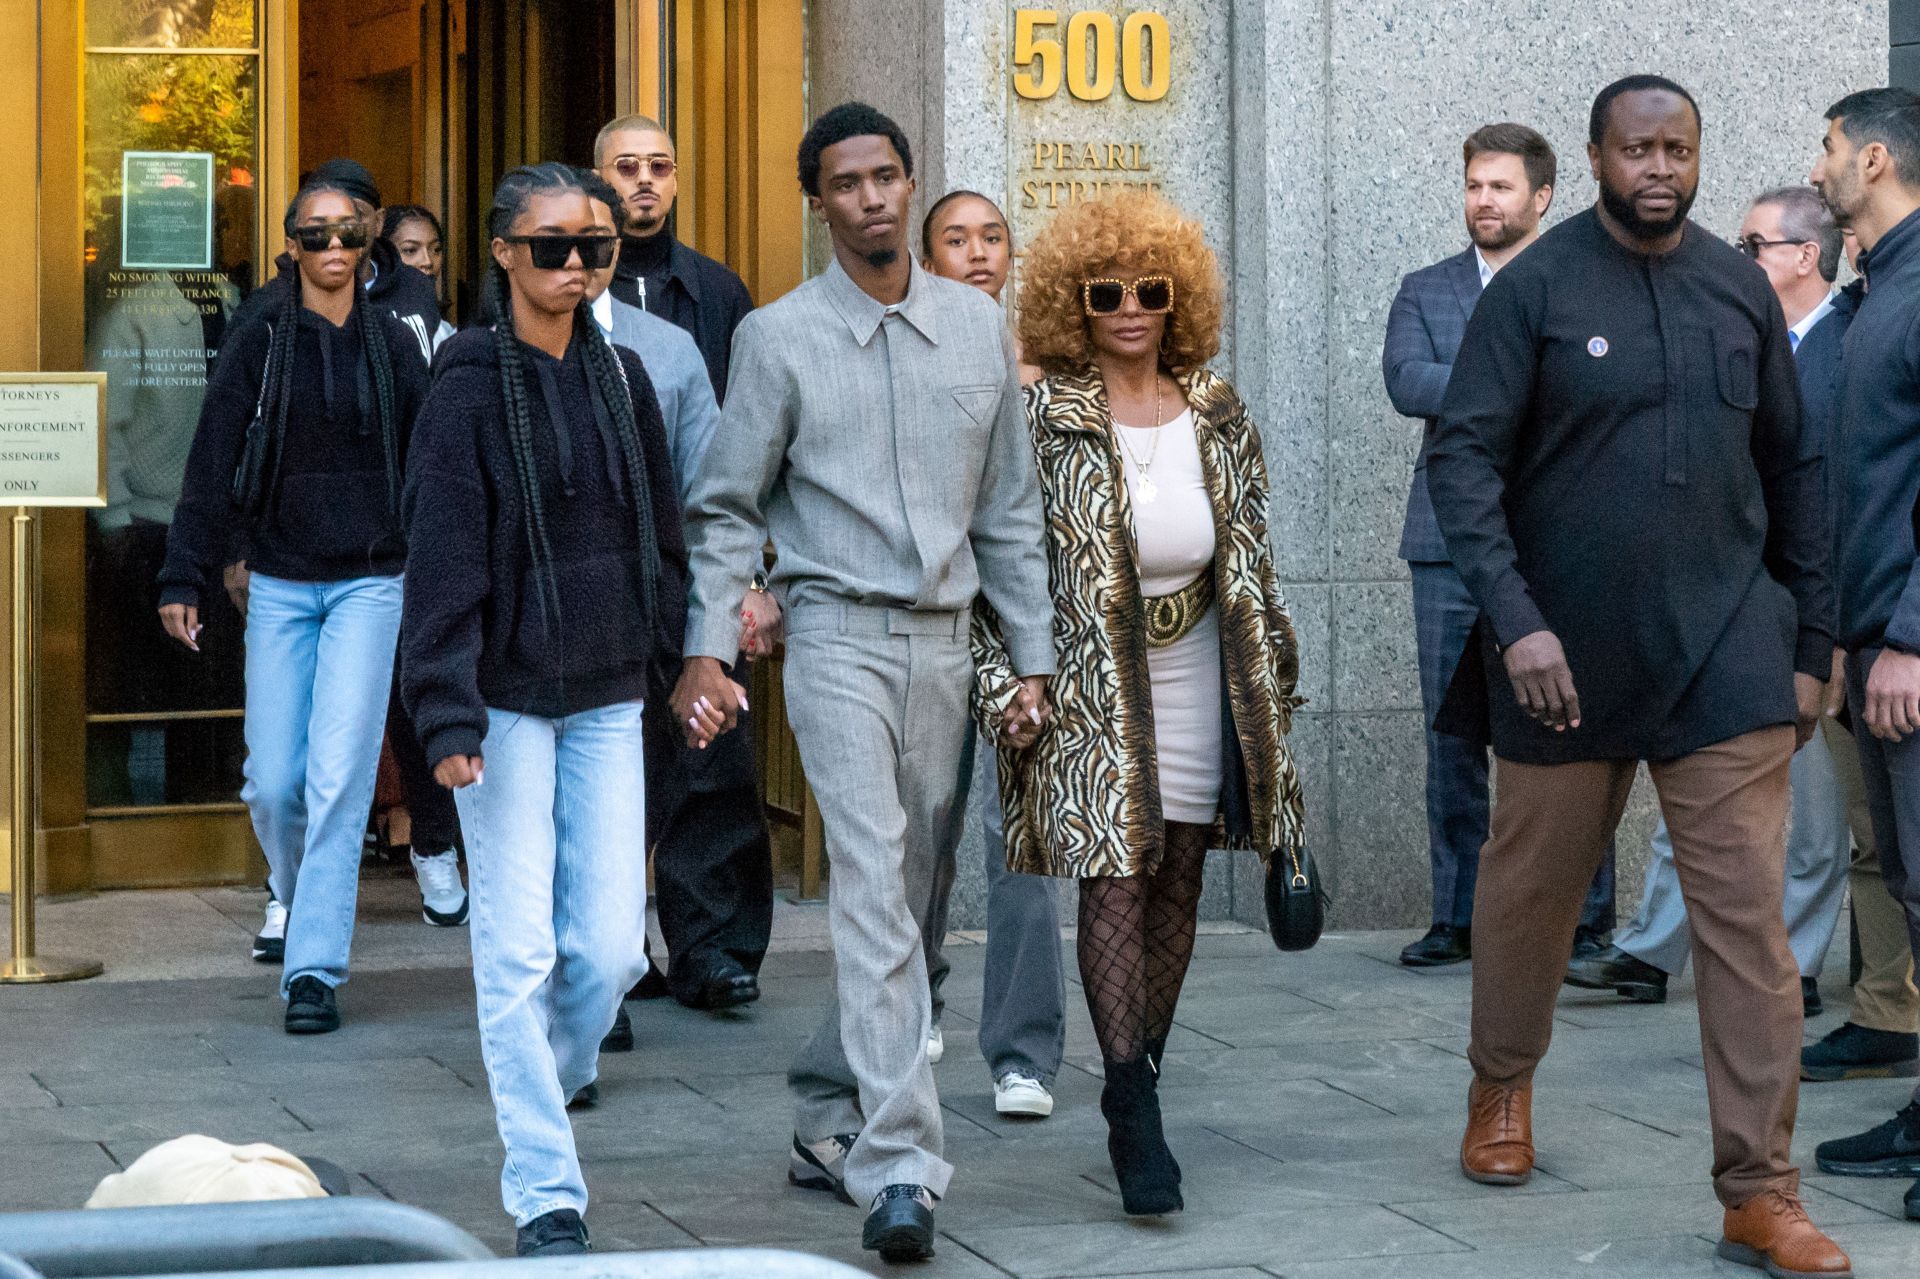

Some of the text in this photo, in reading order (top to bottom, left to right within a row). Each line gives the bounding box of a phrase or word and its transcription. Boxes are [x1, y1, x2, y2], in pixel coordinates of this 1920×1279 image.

[1013, 9, 1171, 101] 500
[1031, 143, 1151, 171] PEARL
[109, 272, 229, 282] NO SMOKING WITHIN
[106, 288, 118, 298] 25
[170, 288, 232, 298] ENTRANCE
[102, 348, 141, 358] PLEASE
[145, 348, 170, 358] WAIT
[173, 348, 205, 358] UNTIL
[145, 363, 177, 372] FULLY
[179, 363, 207, 372] OPEN
[123, 376, 162, 386] EFORE
[4, 480, 39, 490] ONLY
